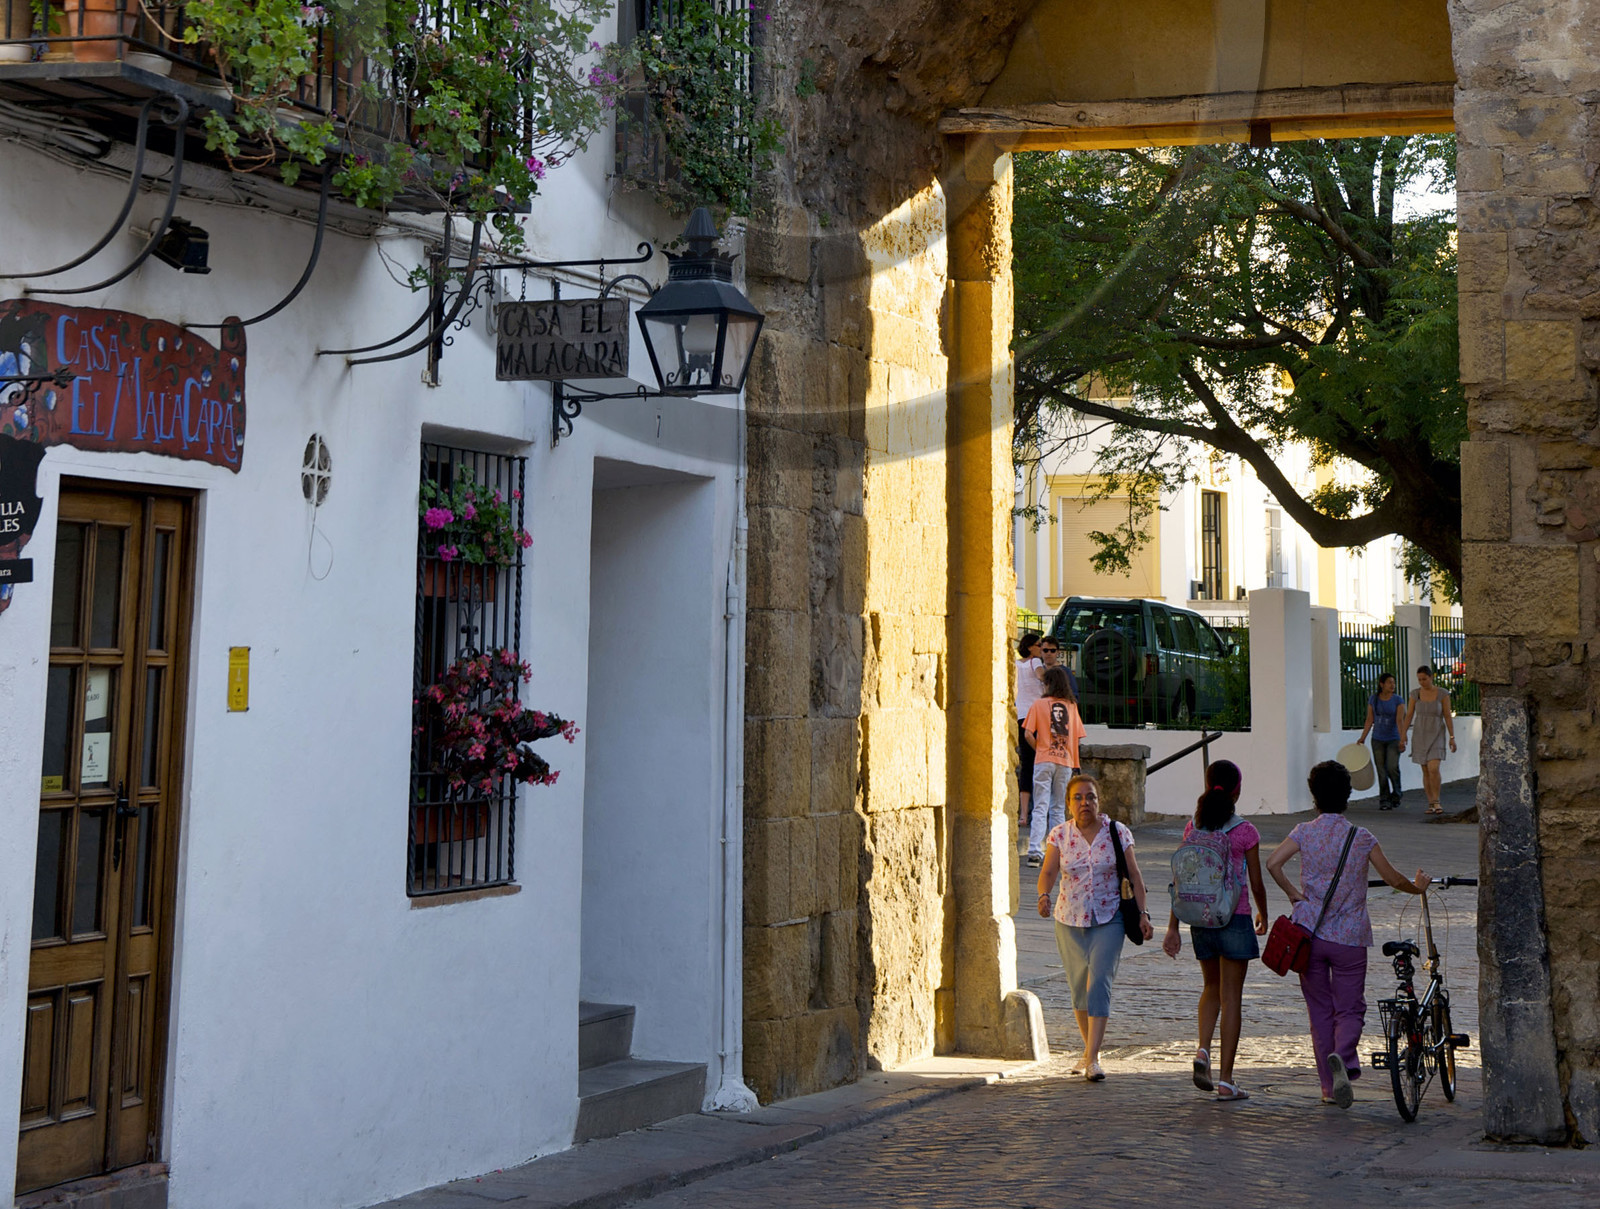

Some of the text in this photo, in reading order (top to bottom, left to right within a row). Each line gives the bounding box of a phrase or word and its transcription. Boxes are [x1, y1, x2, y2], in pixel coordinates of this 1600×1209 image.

[503, 303, 612, 337] CASA EL
[56, 313, 124, 377] CASA
[498, 340, 623, 376] MALACARA
[68, 376, 104, 435] EL
